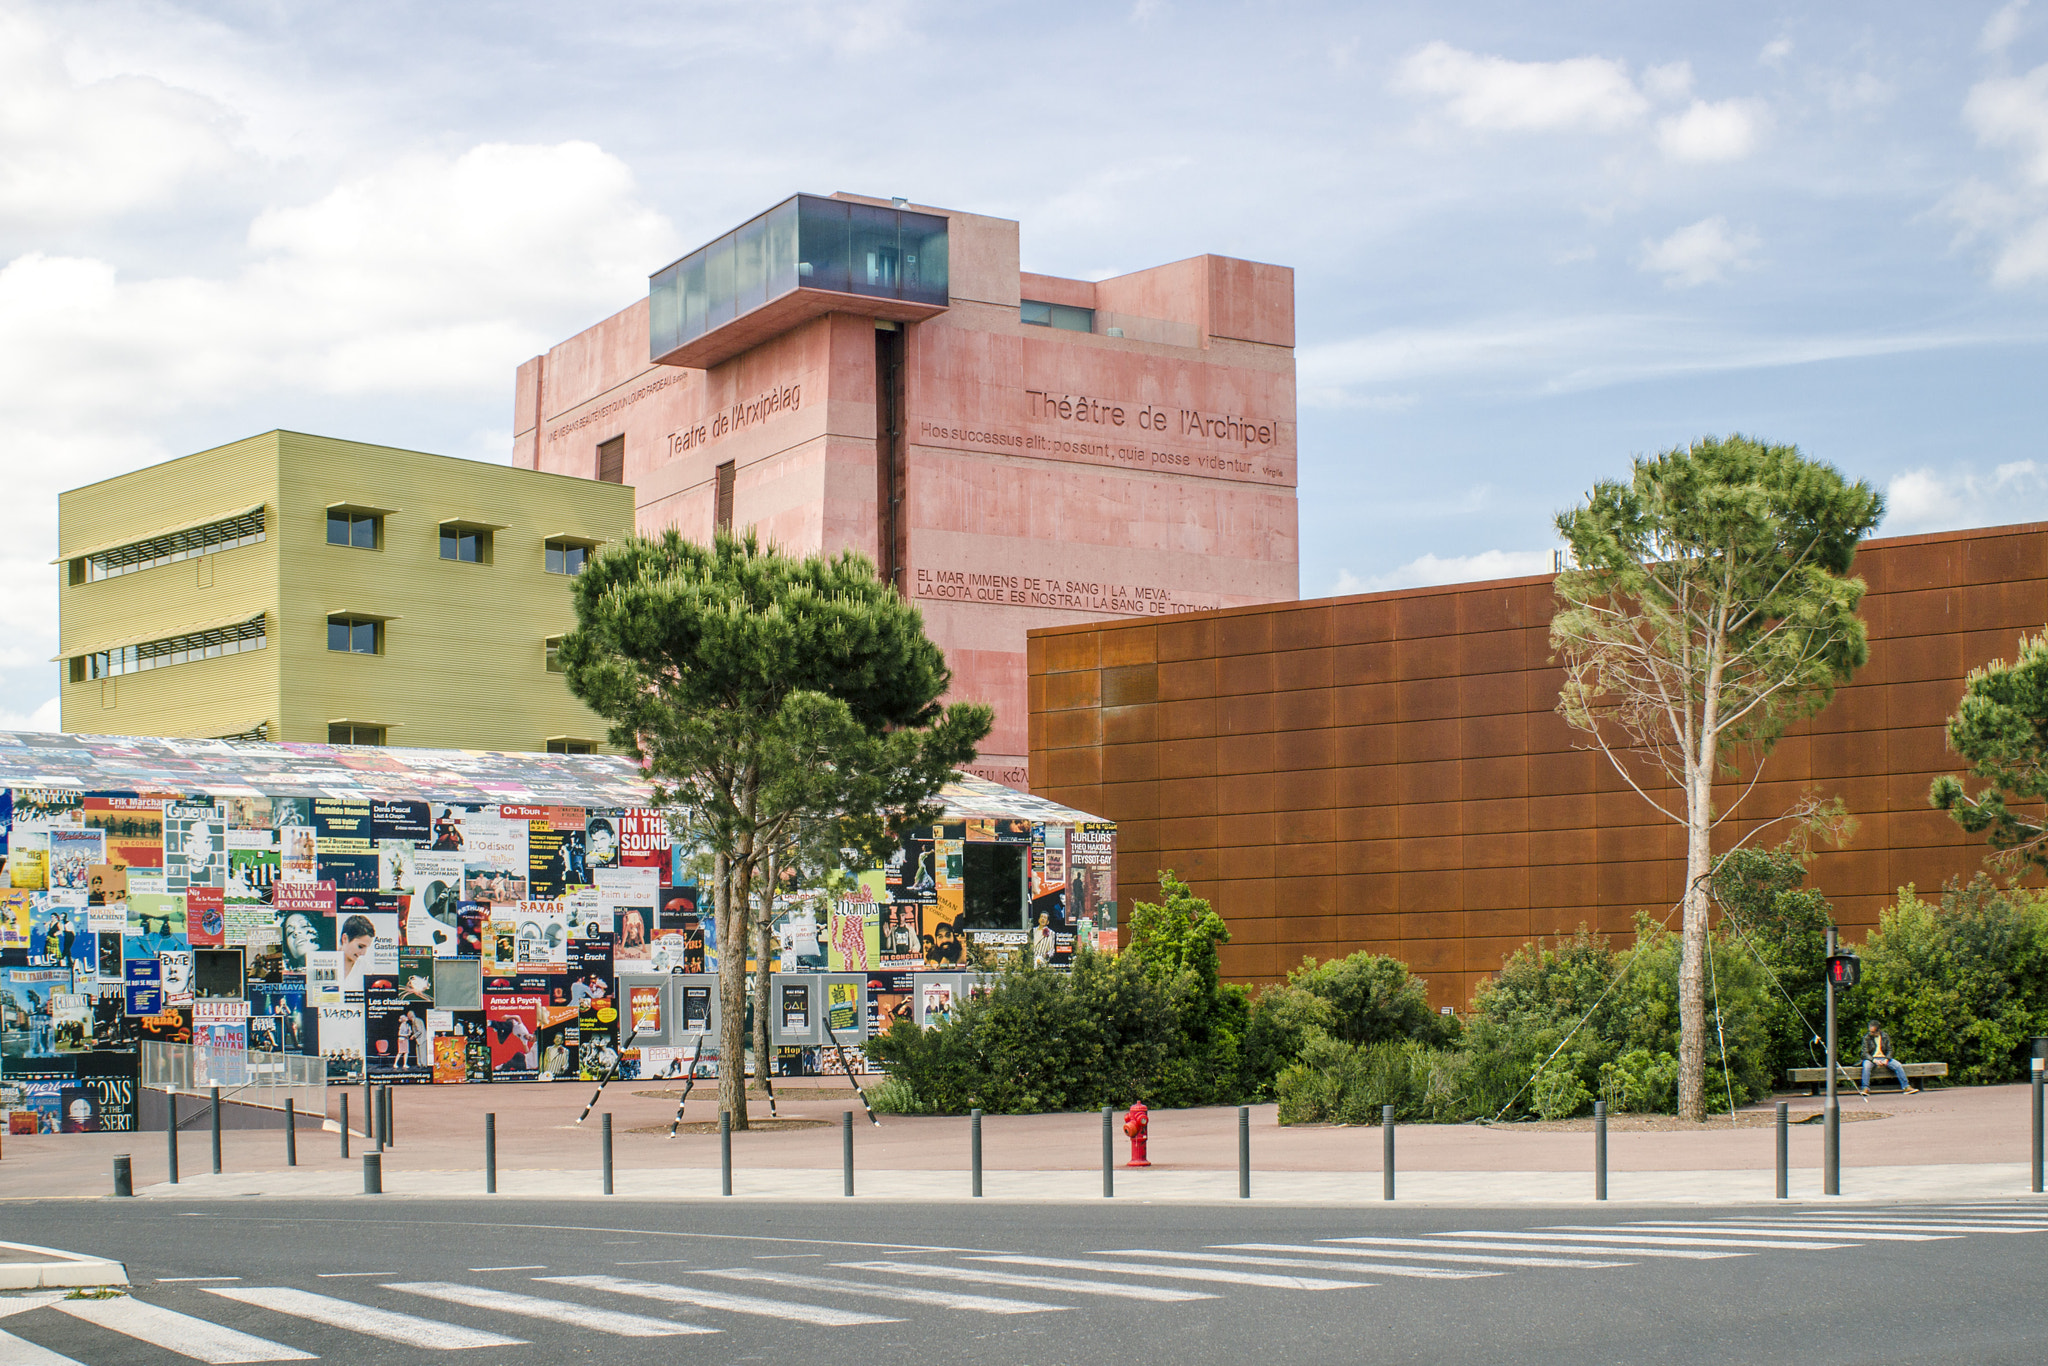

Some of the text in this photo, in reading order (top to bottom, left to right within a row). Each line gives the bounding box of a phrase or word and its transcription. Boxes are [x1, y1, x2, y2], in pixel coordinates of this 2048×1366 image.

[667, 384, 801, 458] Teatre de l'Arxipèlag
[1025, 390, 1277, 448] Théâtre de l'Archipel
[921, 421, 949, 439] Hos
[951, 427, 1023, 447] successus
[1118, 447, 1145, 462] quia
[1151, 450, 1191, 466] posse
[917, 569, 933, 582] EL
[936, 571, 965, 585] MAR
[968, 573, 1018, 589] IMMENS
[1023, 578, 1041, 590] DE
[1046, 580, 1062, 592] TA
[1065, 581, 1099, 595] SANG
[1111, 585, 1127, 598] LA
[1135, 587, 1171, 601] MEVA:
[917, 583, 934, 595] LA
[936, 585, 972, 599] GOTA
[977, 588, 1004, 602] QUE
[1010, 590, 1026, 603] ES
[1031, 592, 1082, 607] NOSTRA
[1093, 597, 1108, 610] LA
[1111, 598, 1144, 613] SANG
[1150, 601, 1166, 614] DE
[29, 794, 76, 804] MURAT
[109, 798, 128, 806] Erik
[622, 817, 637, 833] IN
[621, 834, 671, 851] SOUND
[1070, 832, 1112, 842] HURLEURS
[277, 890, 316, 899] RAMAN
[277, 900, 290, 908] EN
[291, 900, 333, 909] CONCERT
[520, 901, 564, 911] SAYAG
[368, 998, 381, 1006] Les
[323, 1008, 362, 1020] VARDA
[435, 1039, 459, 1051] ZUT
